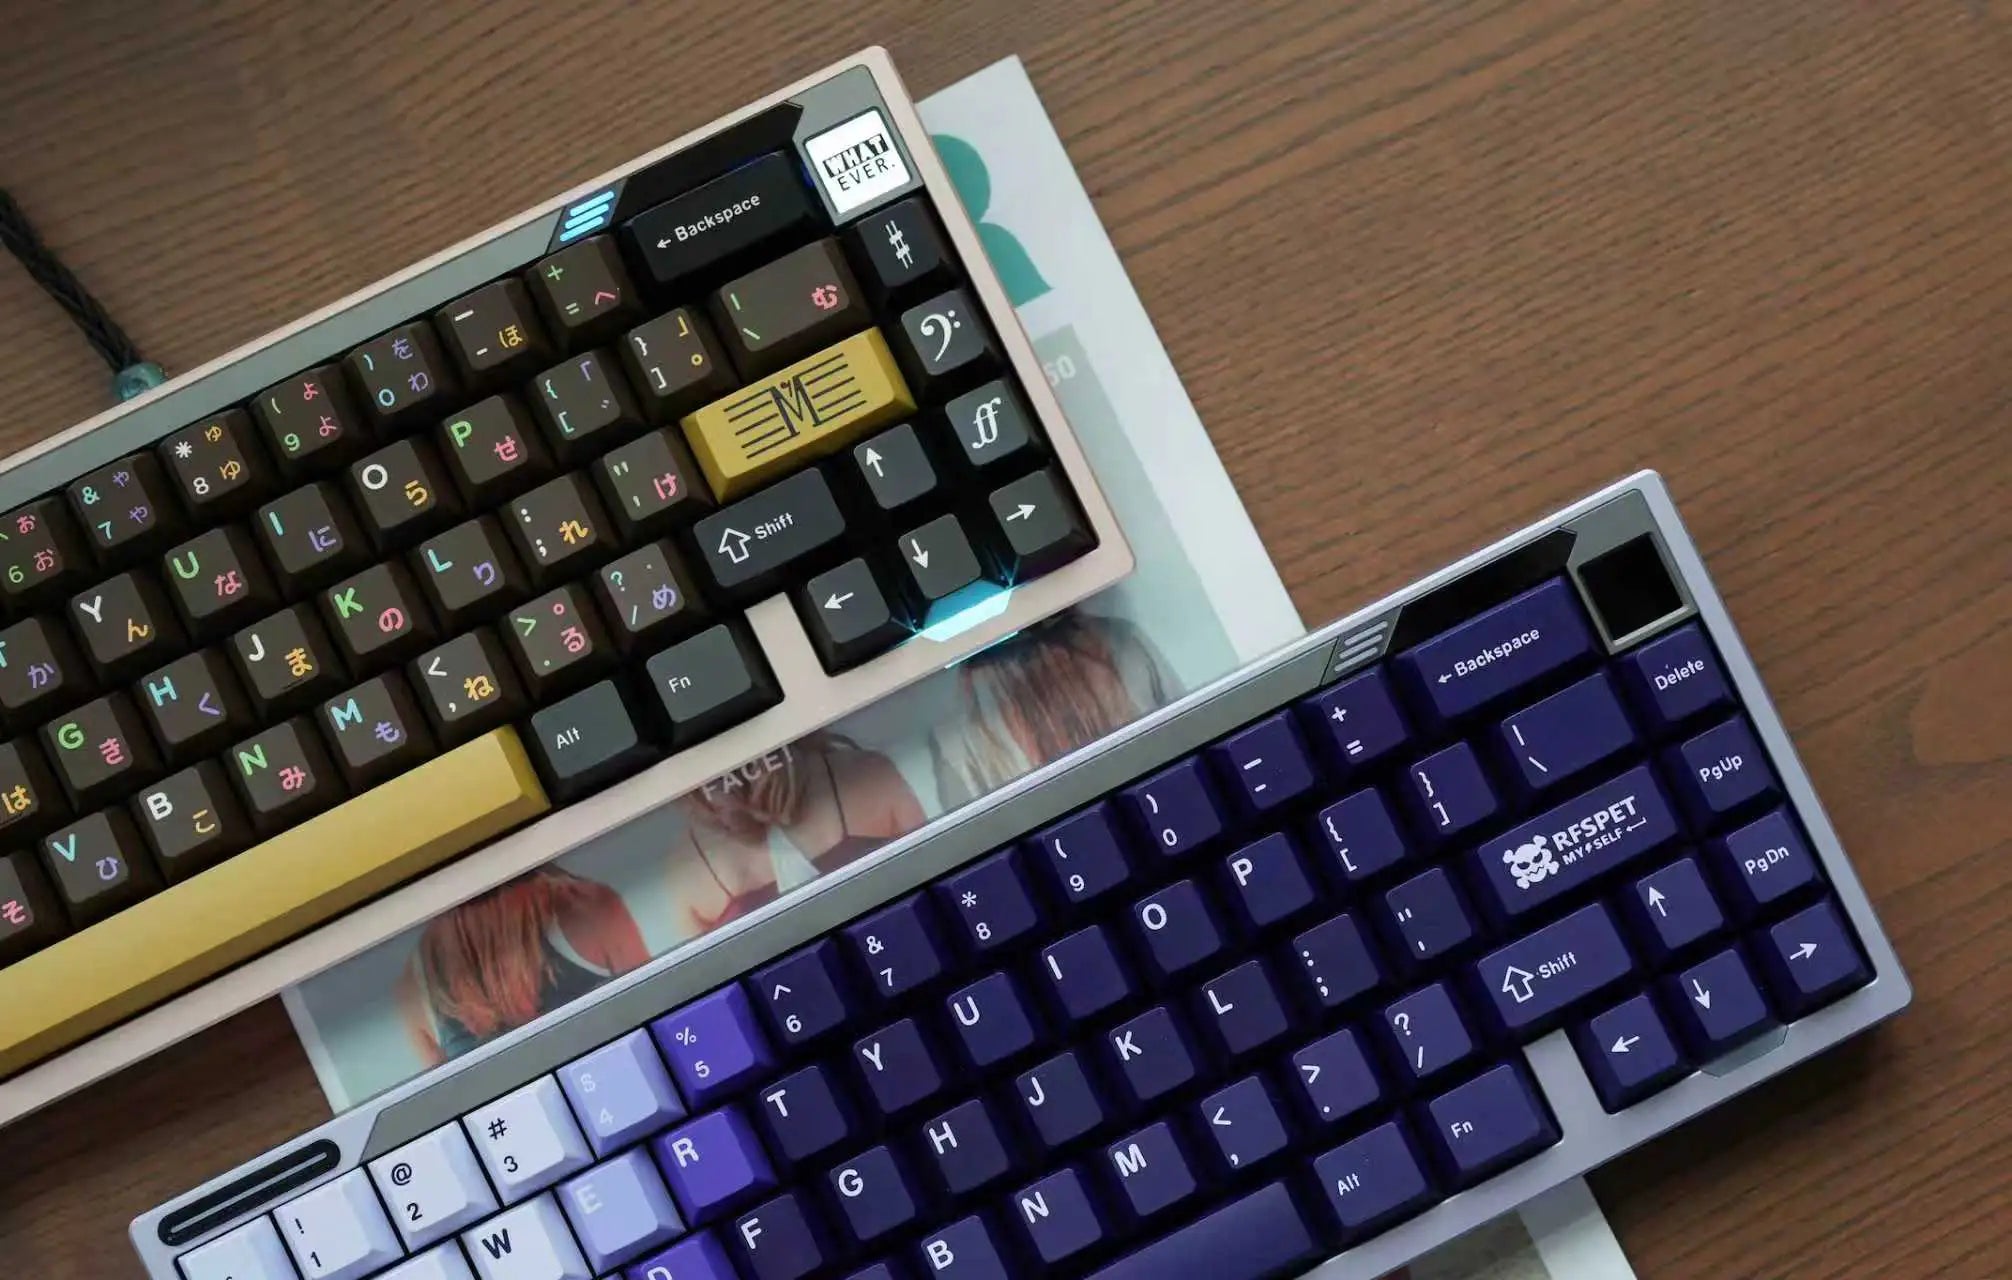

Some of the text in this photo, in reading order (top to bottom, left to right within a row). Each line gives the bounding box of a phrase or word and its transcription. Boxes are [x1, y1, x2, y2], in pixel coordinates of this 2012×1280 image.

[674, 196, 760, 241] Backspace
[379, 389, 394, 406] 0
[285, 433, 300, 451] 9
[451, 421, 472, 447] P
[193, 477, 209, 494] 8
[362, 464, 387, 489] O
[98, 521, 111, 539] 7
[755, 513, 792, 539] Shift
[173, 552, 199, 578] U
[428, 549, 452, 572] L
[9, 566, 23, 583] 6
[80, 596, 102, 622] Y
[335, 588, 363, 618] K
[249, 634, 264, 661] J
[1455, 630, 1539, 676] Backspace
[669, 677, 690, 692] Fn
[1655, 661, 1704, 690] Delete
[149, 676, 176, 706] H
[331, 699, 362, 730] M
[58, 723, 84, 749] G
[557, 728, 579, 749] Alt
[239, 744, 267, 775] N
[1700, 756, 1742, 782] PgUp
[147, 792, 172, 820] B
[1552, 796, 1638, 852] RFSPET
[53, 834, 75, 861] V
[1163, 829, 1177, 846] 0
[1232, 858, 1252, 886] P
[1745, 847, 1789, 874] PgDn
[1070, 875, 1084, 891] 9
[1143, 904, 1166, 930] O
[976, 923, 991, 940] 8
[880, 968, 892, 986] 7
[1537, 952, 1576, 978] Shift
[954, 996, 979, 1025] U
[1208, 990, 1233, 1014] L
[786, 1015, 801, 1032] 6
[863, 1043, 883, 1070] Y
[1115, 1031, 1142, 1060] K
[695, 1061, 709, 1077] 5
[767, 1090, 787, 1116] T
[1029, 1077, 1044, 1105] J
[600, 1108, 613, 1124] 4
[929, 1122, 957, 1154] H
[1451, 1122, 1473, 1138] Fn
[504, 1156, 518, 1172] 3
[672, 1138, 699, 1167] R
[1115, 1144, 1146, 1176] M
[839, 1169, 863, 1196] G
[1338, 1174, 1359, 1195] Alt
[407, 1203, 422, 1221] 2
[576, 1185, 602, 1214] E
[1022, 1192, 1049, 1223] N
[482, 1229, 511, 1259] W
[741, 1218, 761, 1249] F
[311, 1252, 321, 1267] 1
[927, 1240, 953, 1270] B
